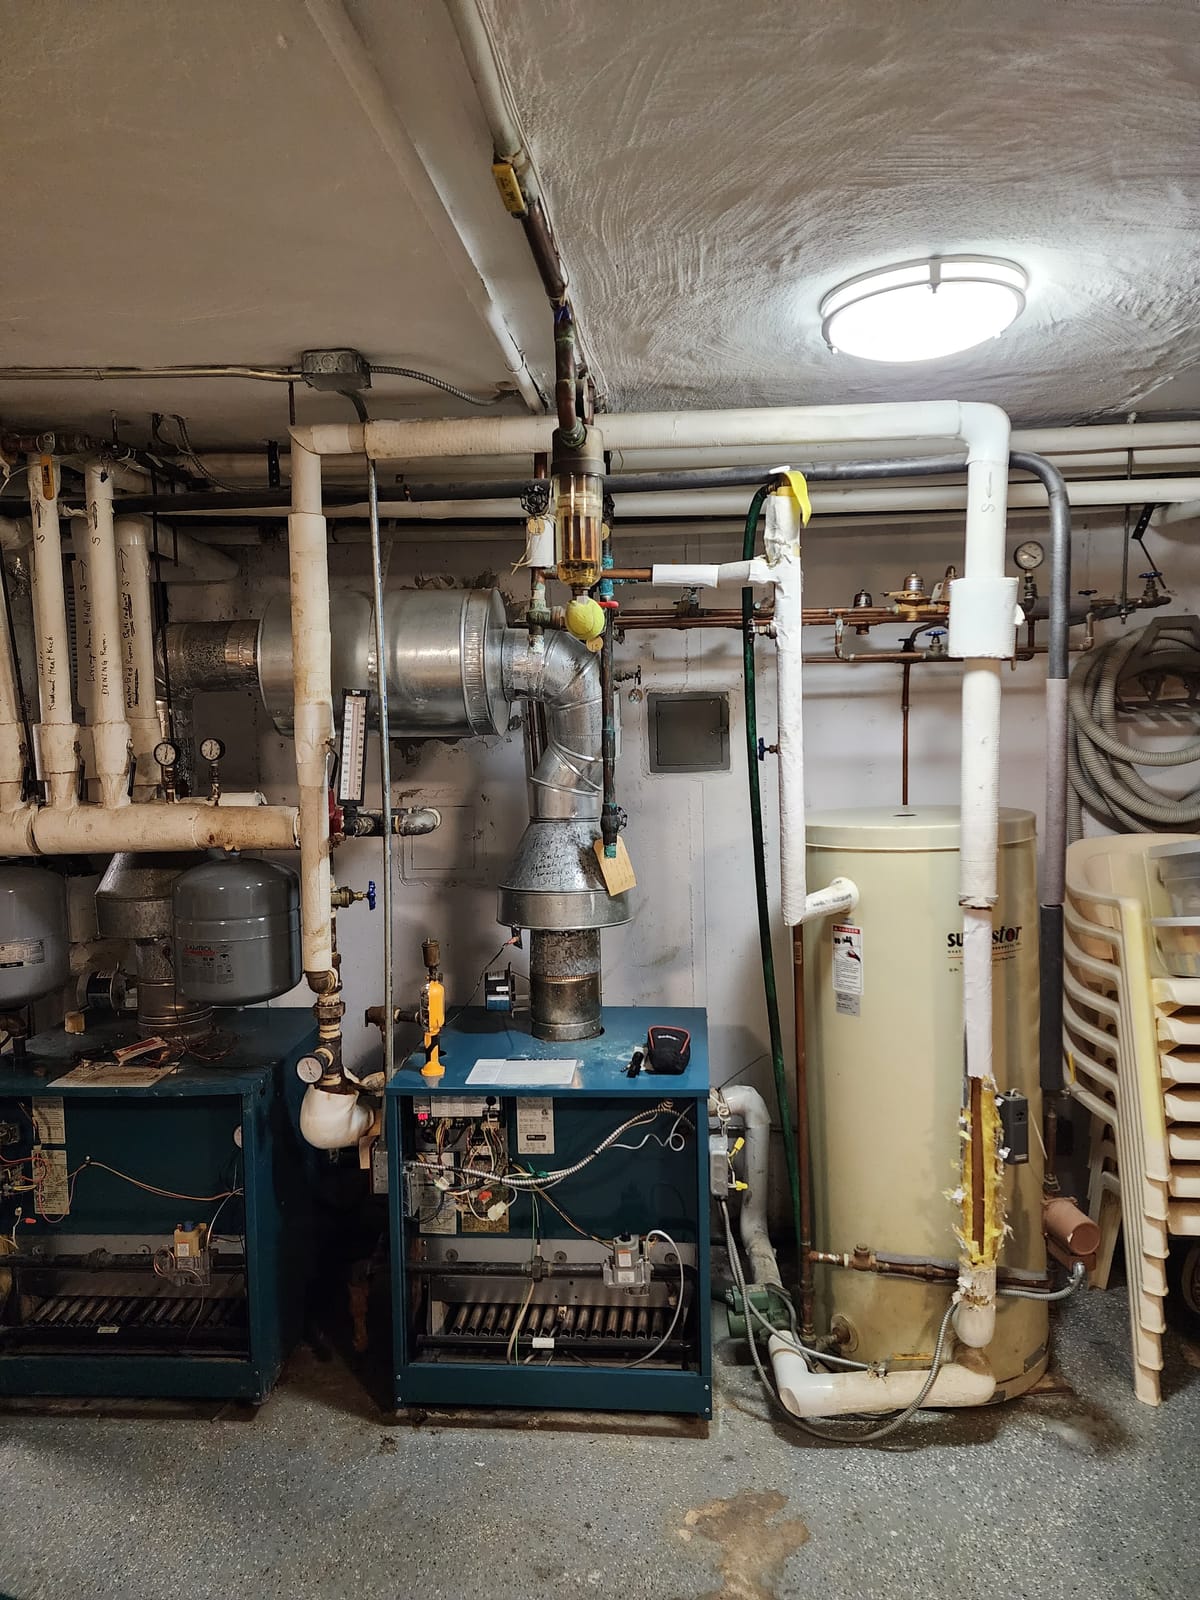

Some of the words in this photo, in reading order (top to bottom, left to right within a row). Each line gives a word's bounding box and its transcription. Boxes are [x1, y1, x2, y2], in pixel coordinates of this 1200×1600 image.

[36, 534, 45, 544] S
[91, 536, 101, 546] S
[947, 925, 1023, 948] sustor
